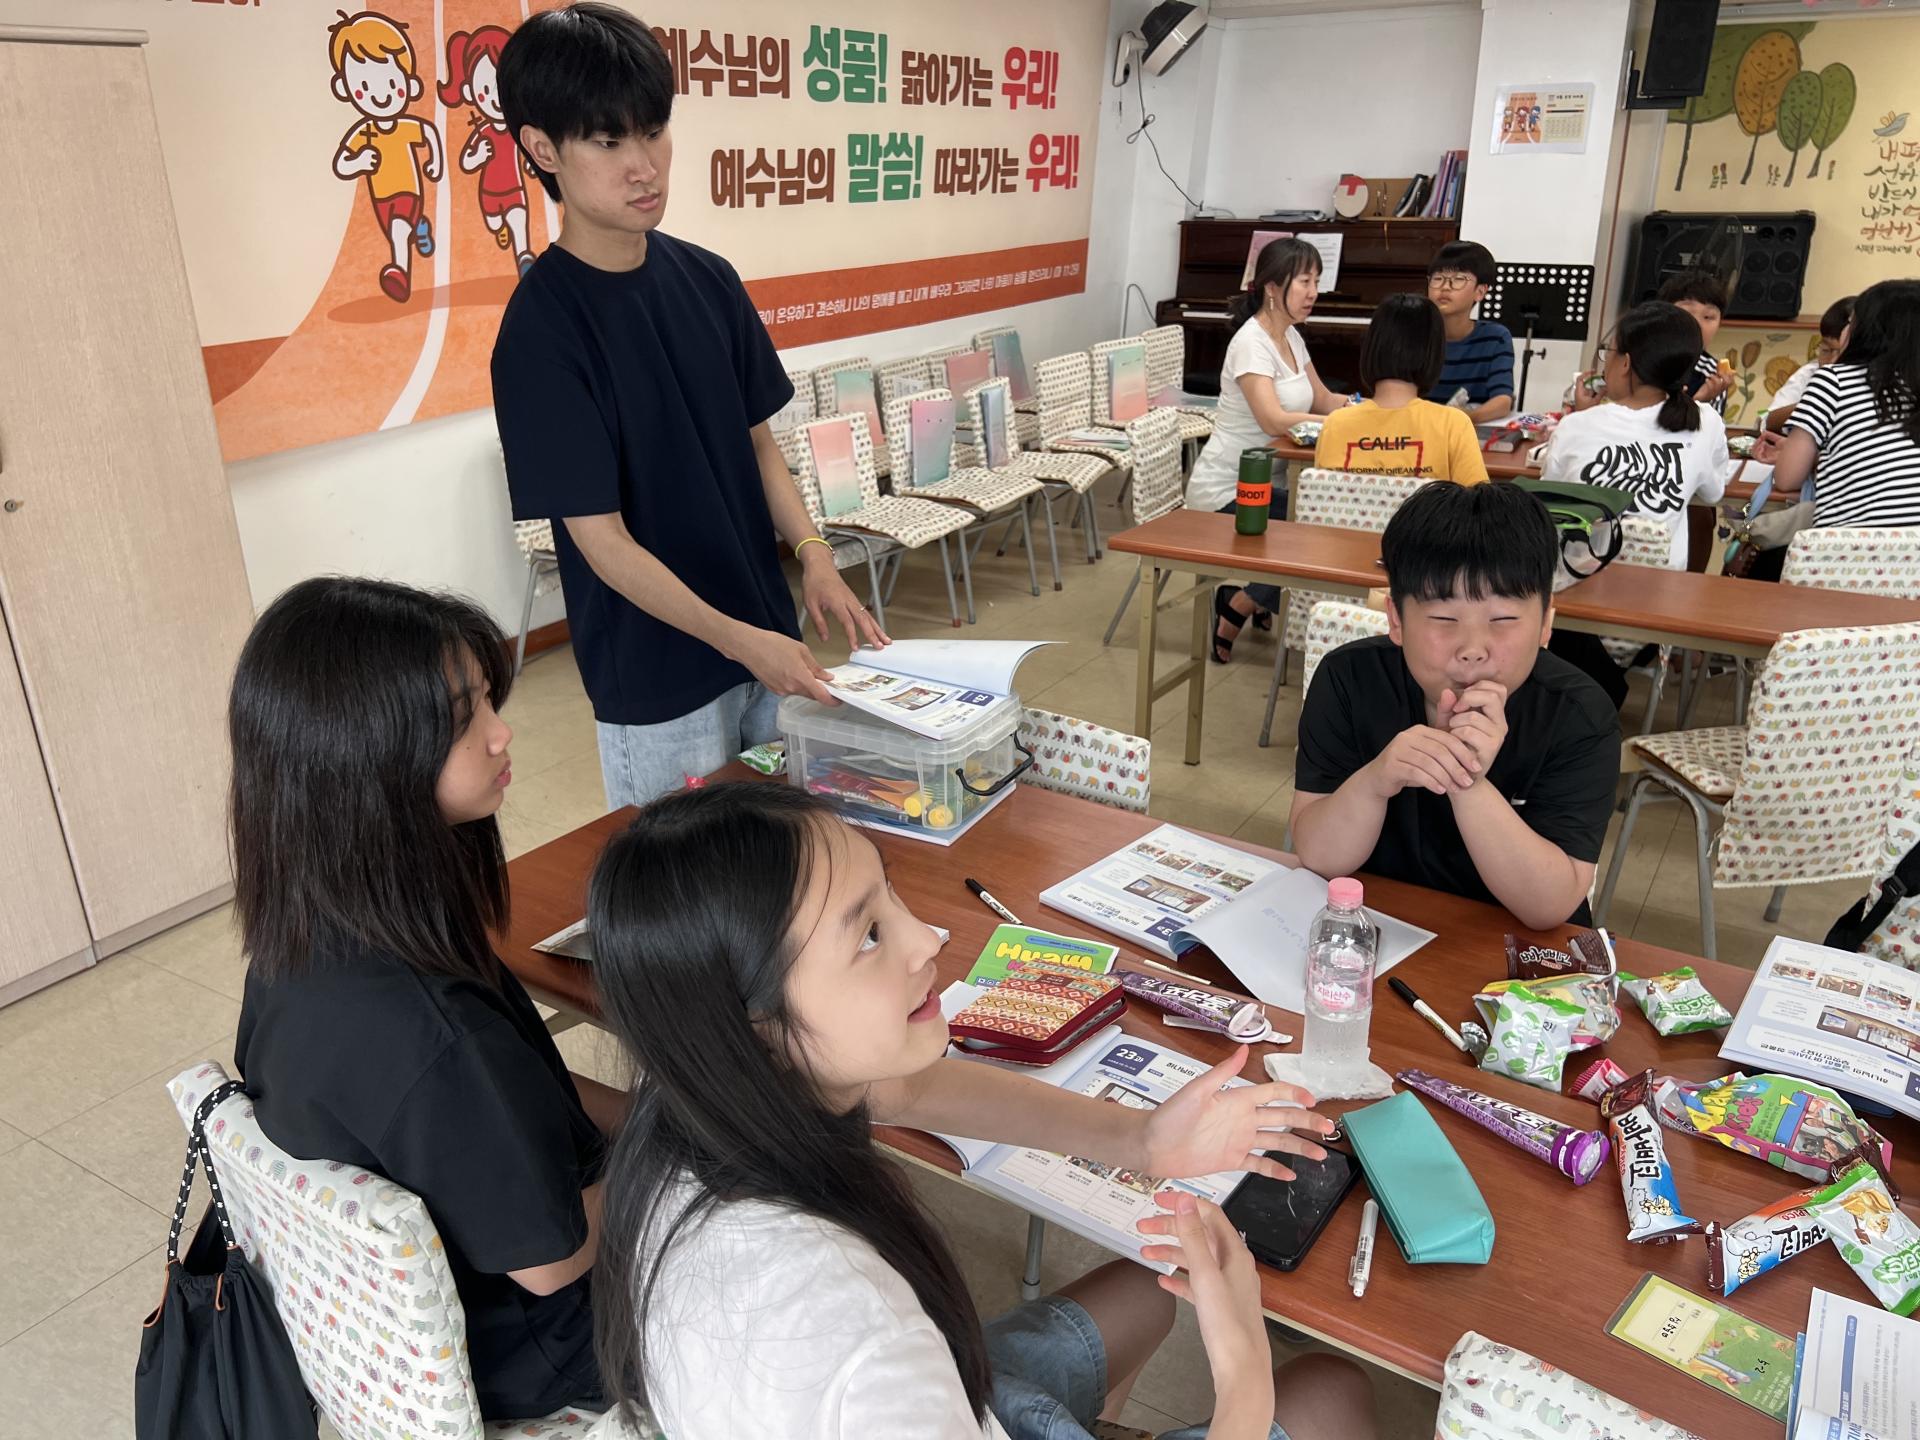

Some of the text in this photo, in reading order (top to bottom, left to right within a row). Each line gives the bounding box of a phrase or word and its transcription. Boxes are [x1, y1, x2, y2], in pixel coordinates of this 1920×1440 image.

[652, 25, 1059, 110] 예수님의 성품! 닮아가는 우리!
[710, 132, 1080, 208] 예수님의 말씀! 따라가는 우리!
[777, 302, 815, 325] 온유하고
[816, 298, 852, 318] 겸손하니
[853, 294, 870, 312] 나의
[1358, 436, 1412, 451] CALIF
[1116, 1048, 1144, 1063] 23과
[1617, 1112, 1662, 1188] 빠삐코
[1772, 1224, 1828, 1262] 삐코
